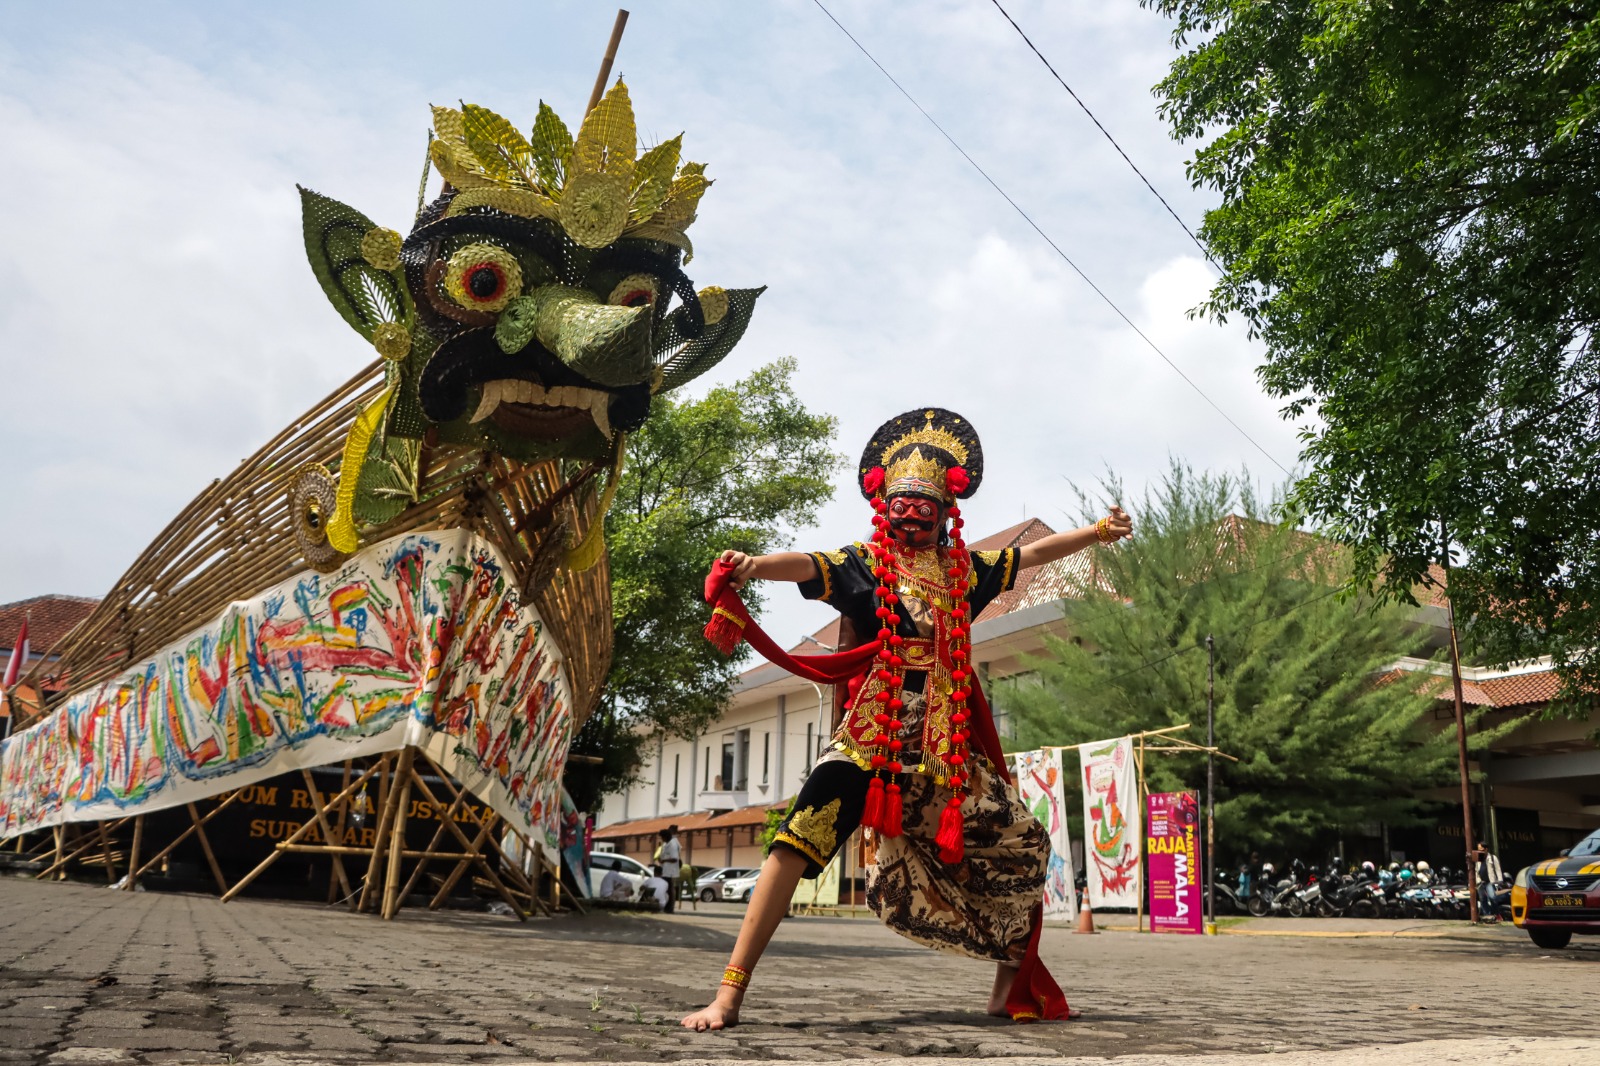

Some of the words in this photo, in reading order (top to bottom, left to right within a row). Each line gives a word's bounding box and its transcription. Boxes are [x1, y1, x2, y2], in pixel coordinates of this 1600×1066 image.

[249, 818, 408, 849] SURAAR
[1147, 836, 1187, 855] RAJA
[1185, 825, 1195, 886] PAMERAN
[1174, 854, 1189, 918] MALA
